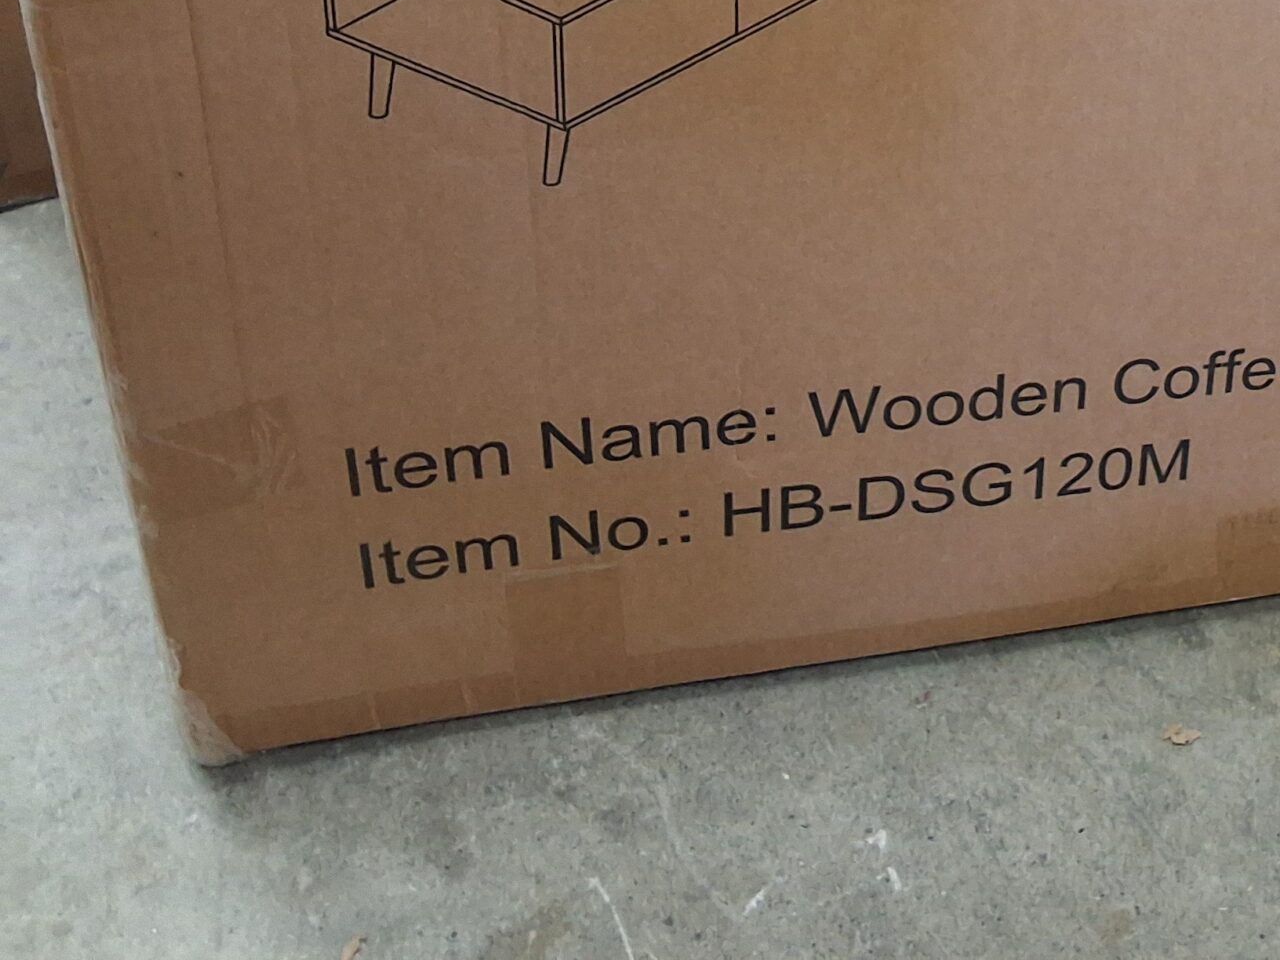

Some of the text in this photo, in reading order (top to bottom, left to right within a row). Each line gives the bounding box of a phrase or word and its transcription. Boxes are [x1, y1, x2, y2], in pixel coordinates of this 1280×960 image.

[345, 441, 511, 497] Item
[540, 407, 776, 470] Name:
[807, 374, 1087, 438] Wooden
[359, 433, 1192, 589] Item No.: HB-DSG120M
